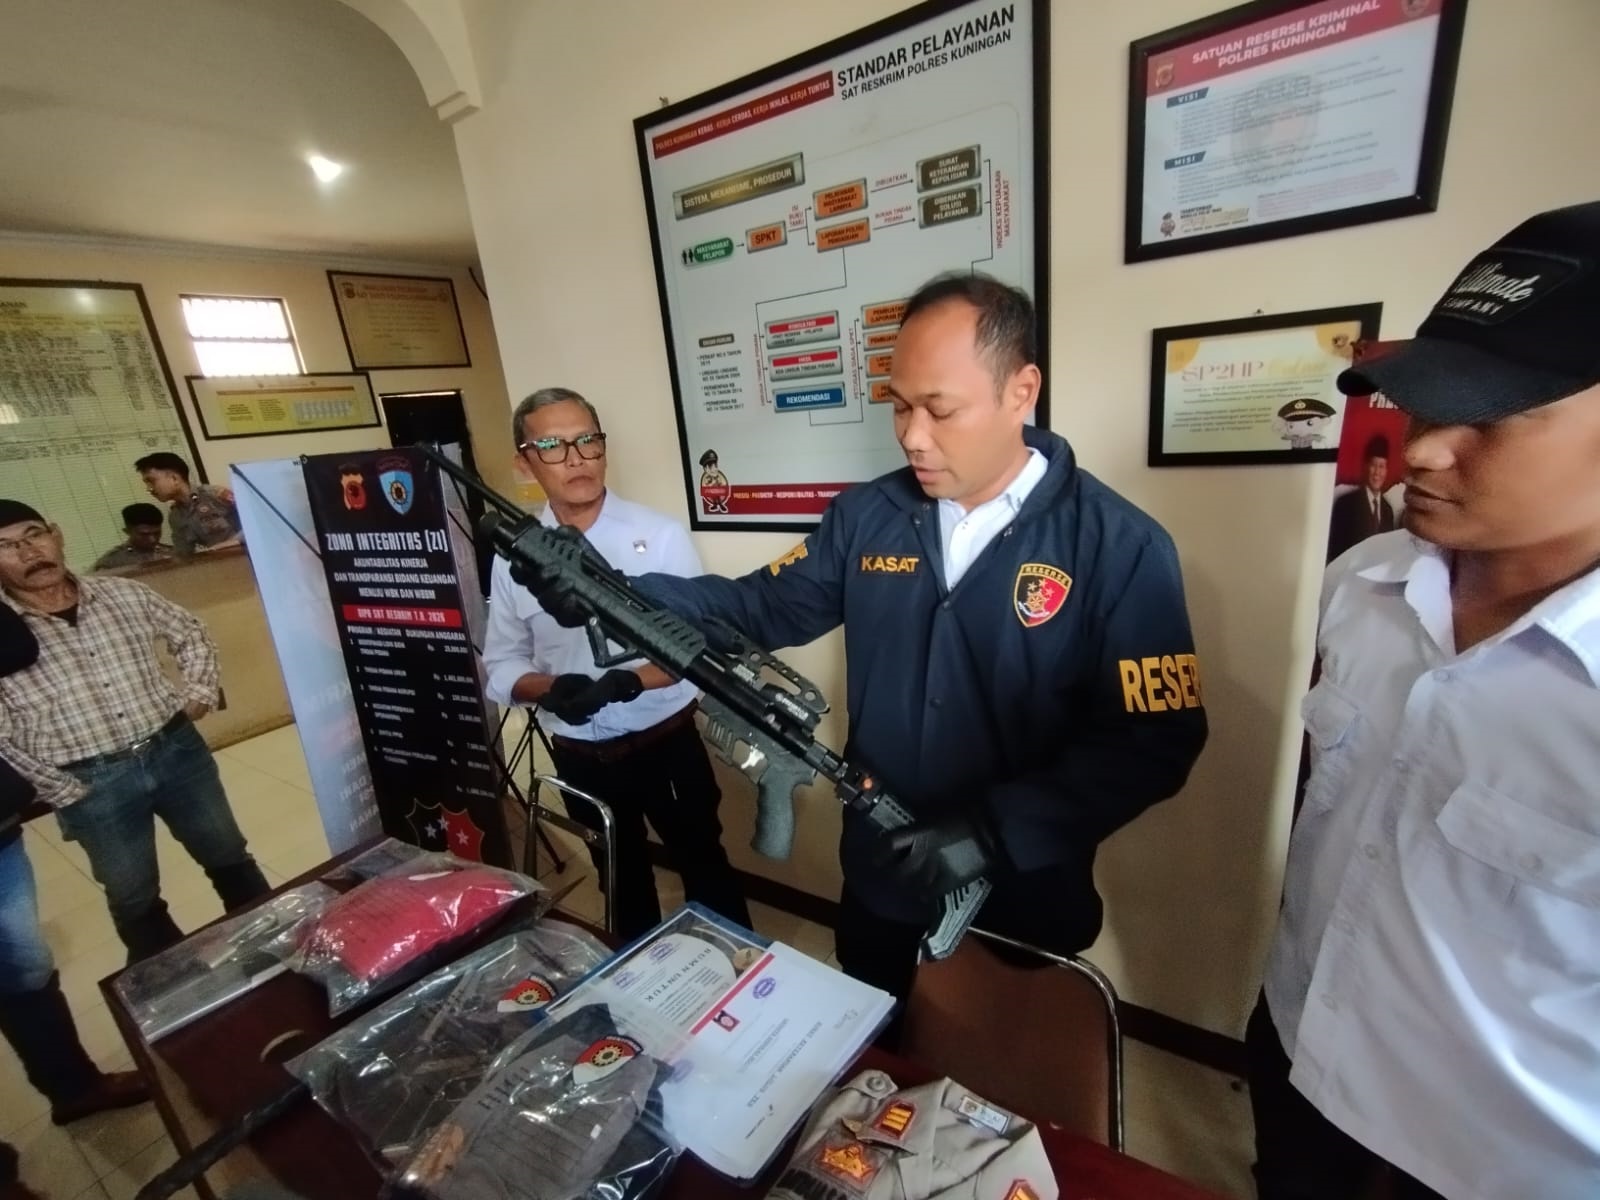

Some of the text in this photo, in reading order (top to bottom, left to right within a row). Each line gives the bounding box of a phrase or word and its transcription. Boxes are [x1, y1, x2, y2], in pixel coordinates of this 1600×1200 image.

[1192, 1, 1381, 64] SATUAN RESERSE KRIMINAL
[838, 4, 1014, 87] STANDAR PELAYANAN
[1218, 21, 1347, 69] POLRES KUNINGAN
[841, 29, 1011, 101] SAT RESKRIM POLRES KUNINGAN
[808, 79, 831, 95] TUNTAS
[1177, 91, 1200, 104] VISI
[1174, 155, 1196, 167] MISI
[753, 167, 792, 186] PROSEDUR
[755, 231, 776, 244] SPKT
[786, 392, 831, 405] REKOMENDASI
[325, 533, 354, 551] ZONA
[356, 531, 423, 551] INTEGRITAS
[861, 555, 920, 574] KASAT
[420, 574, 457, 585] KEUANGAN
[1025, 566, 1069, 585] RESERSE
